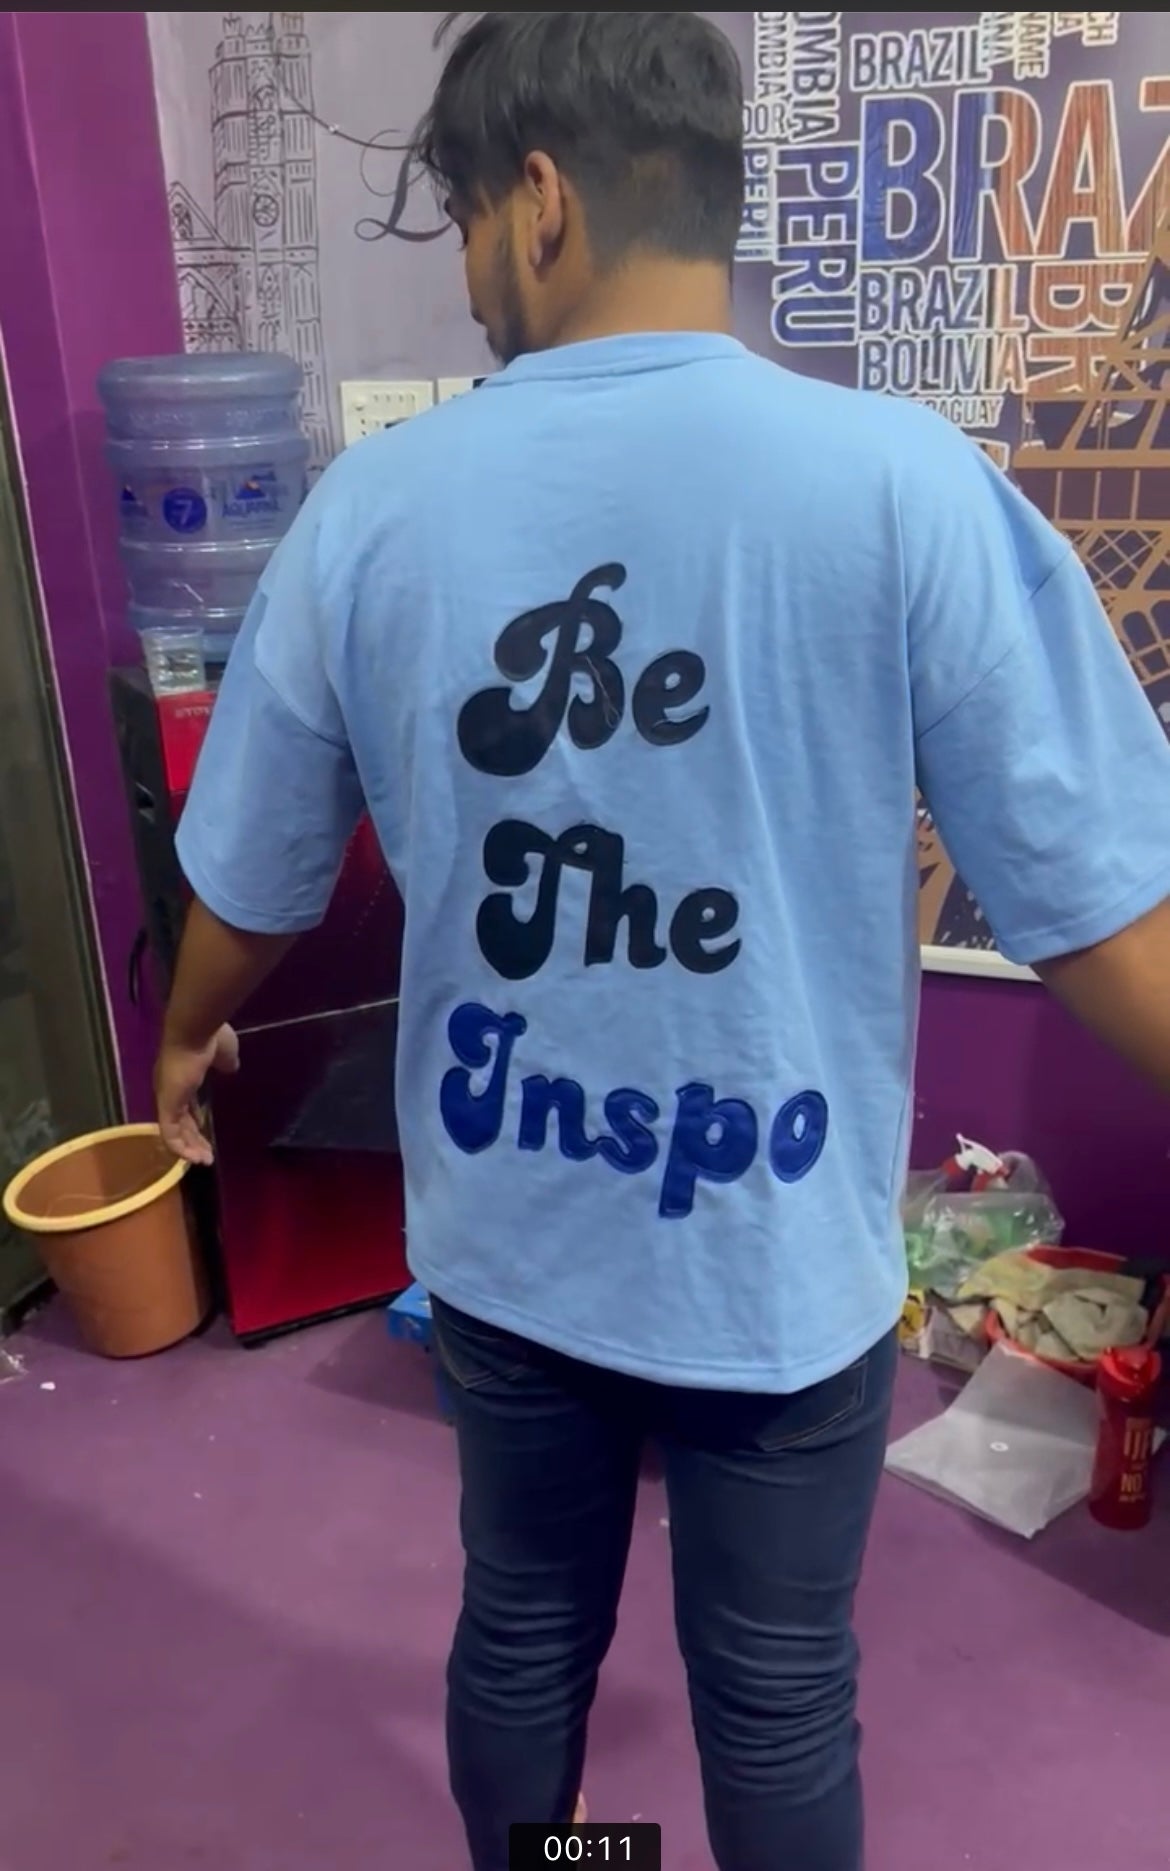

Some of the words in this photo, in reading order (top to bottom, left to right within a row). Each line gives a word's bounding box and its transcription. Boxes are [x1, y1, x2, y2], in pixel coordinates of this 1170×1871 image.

[852, 27, 990, 89] BRAZIL
[773, 143, 864, 346] PERU
[858, 264, 1030, 332] BRAZIL
[860, 334, 1029, 393] BOLIVIA
[457, 562, 711, 778] Be
[475, 819, 743, 981] The
[439, 1002, 829, 1220] Inspo
